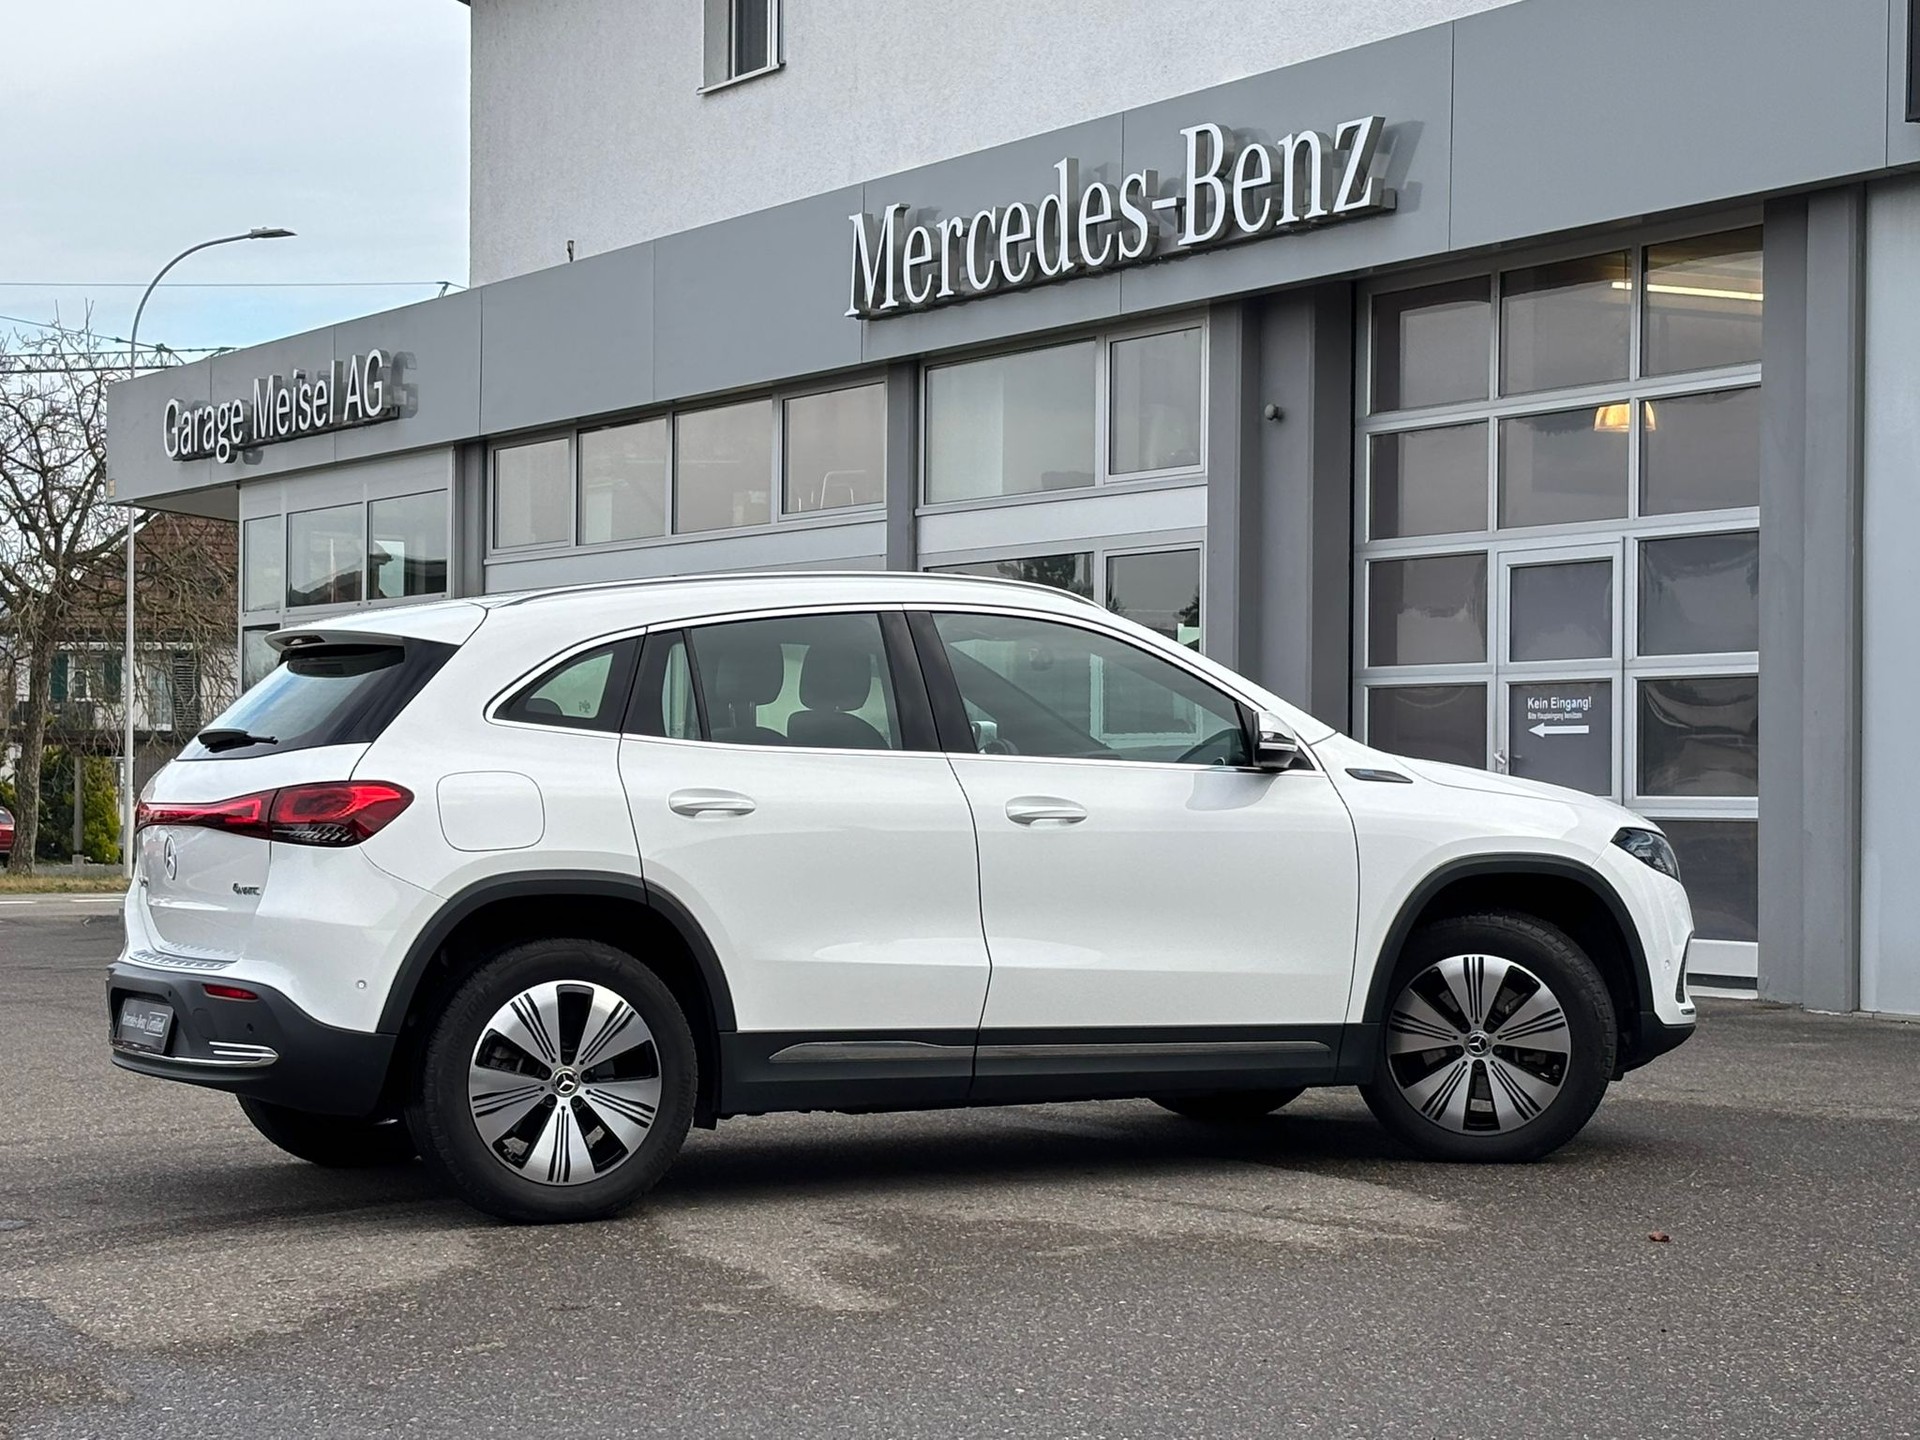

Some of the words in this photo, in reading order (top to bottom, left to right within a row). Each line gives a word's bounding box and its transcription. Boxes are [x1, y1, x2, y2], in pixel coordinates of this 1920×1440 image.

[844, 115, 1386, 317] Mercedes-Benz
[164, 398, 244, 464] Garage
[253, 359, 337, 440] Meisel
[343, 349, 384, 421] AG
[1527, 697, 1548, 709] Kein
[1550, 696, 1592, 711] Eingang!
